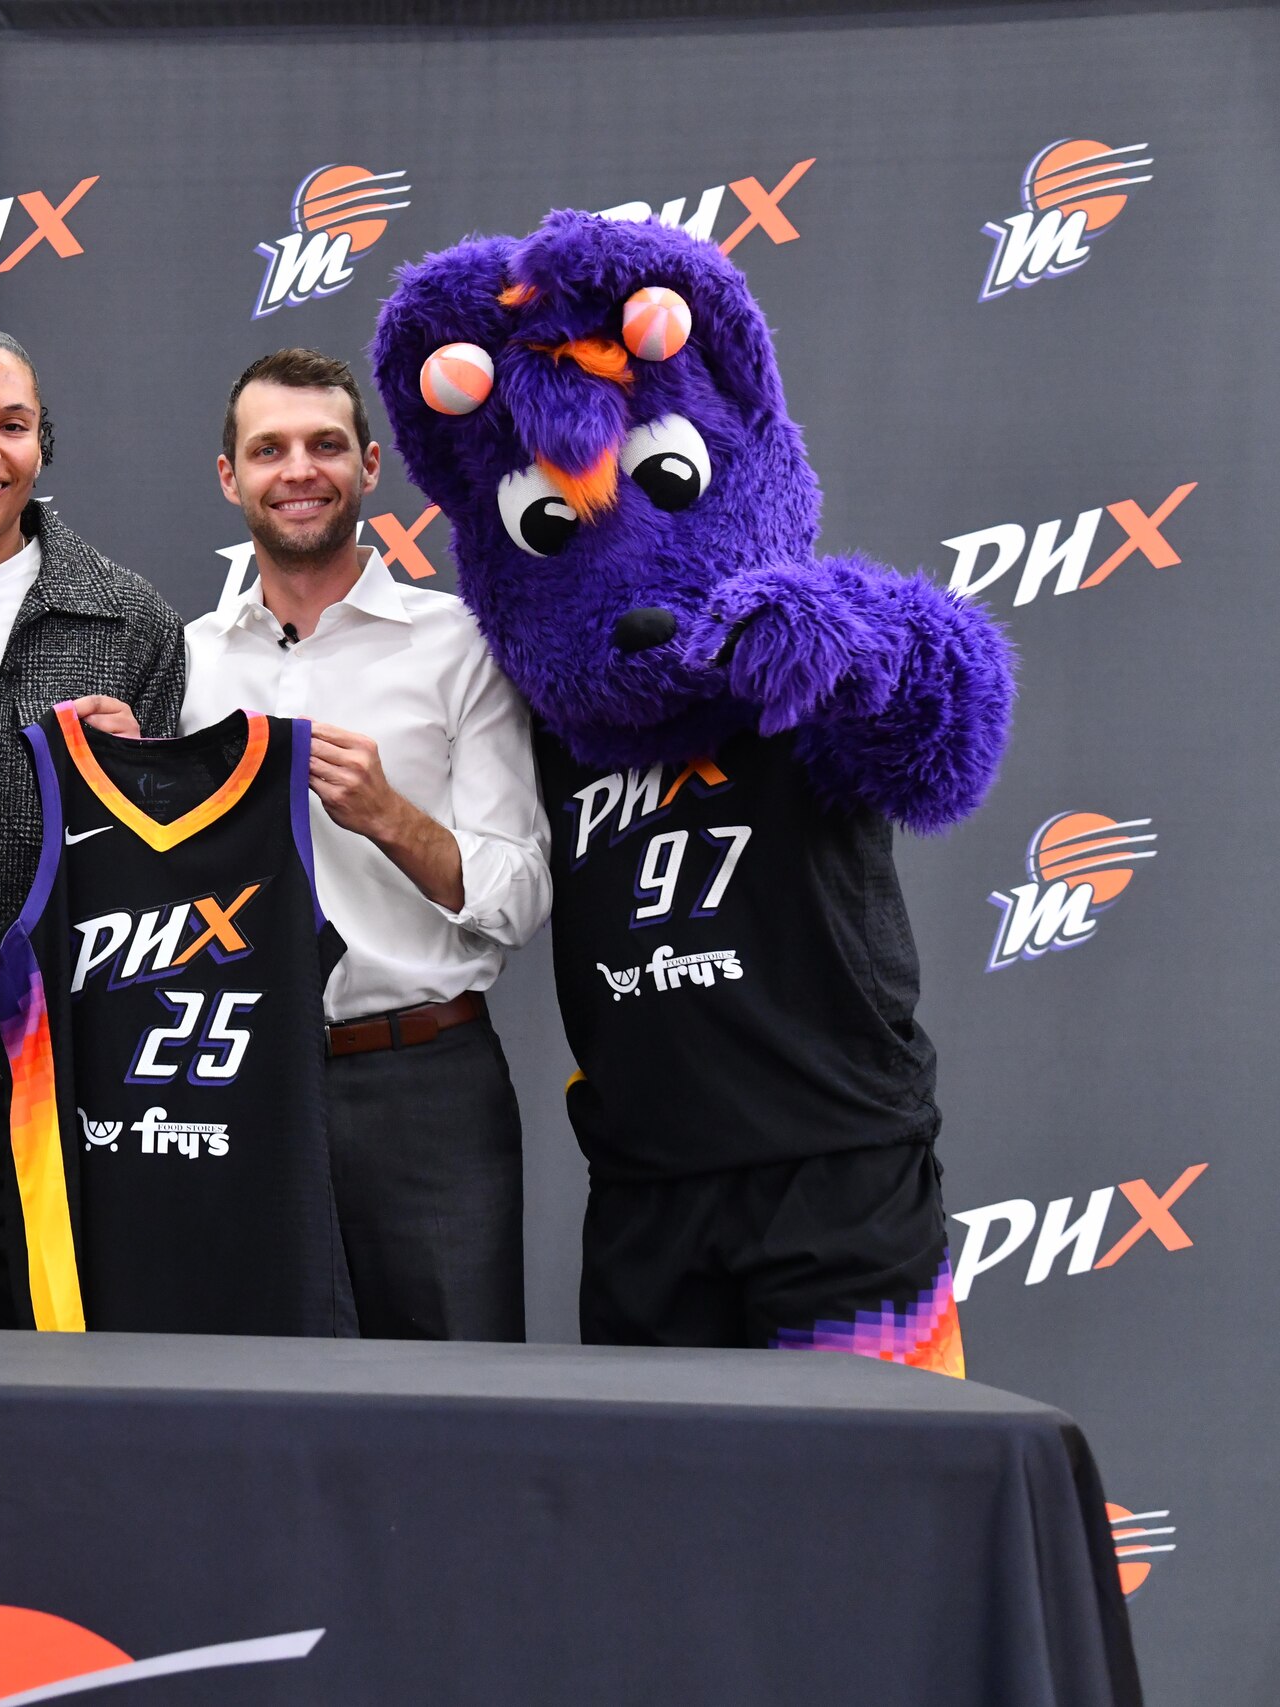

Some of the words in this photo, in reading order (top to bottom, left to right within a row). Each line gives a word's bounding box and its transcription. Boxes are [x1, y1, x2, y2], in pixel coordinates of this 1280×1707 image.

[940, 481, 1199, 607] PHX
[634, 824, 753, 920] 97
[70, 883, 262, 994] PHX
[132, 990, 265, 1079] 25
[157, 1123, 184, 1131] FOOD
[185, 1124, 224, 1133] STORES
[950, 1162, 1210, 1303] PHX
